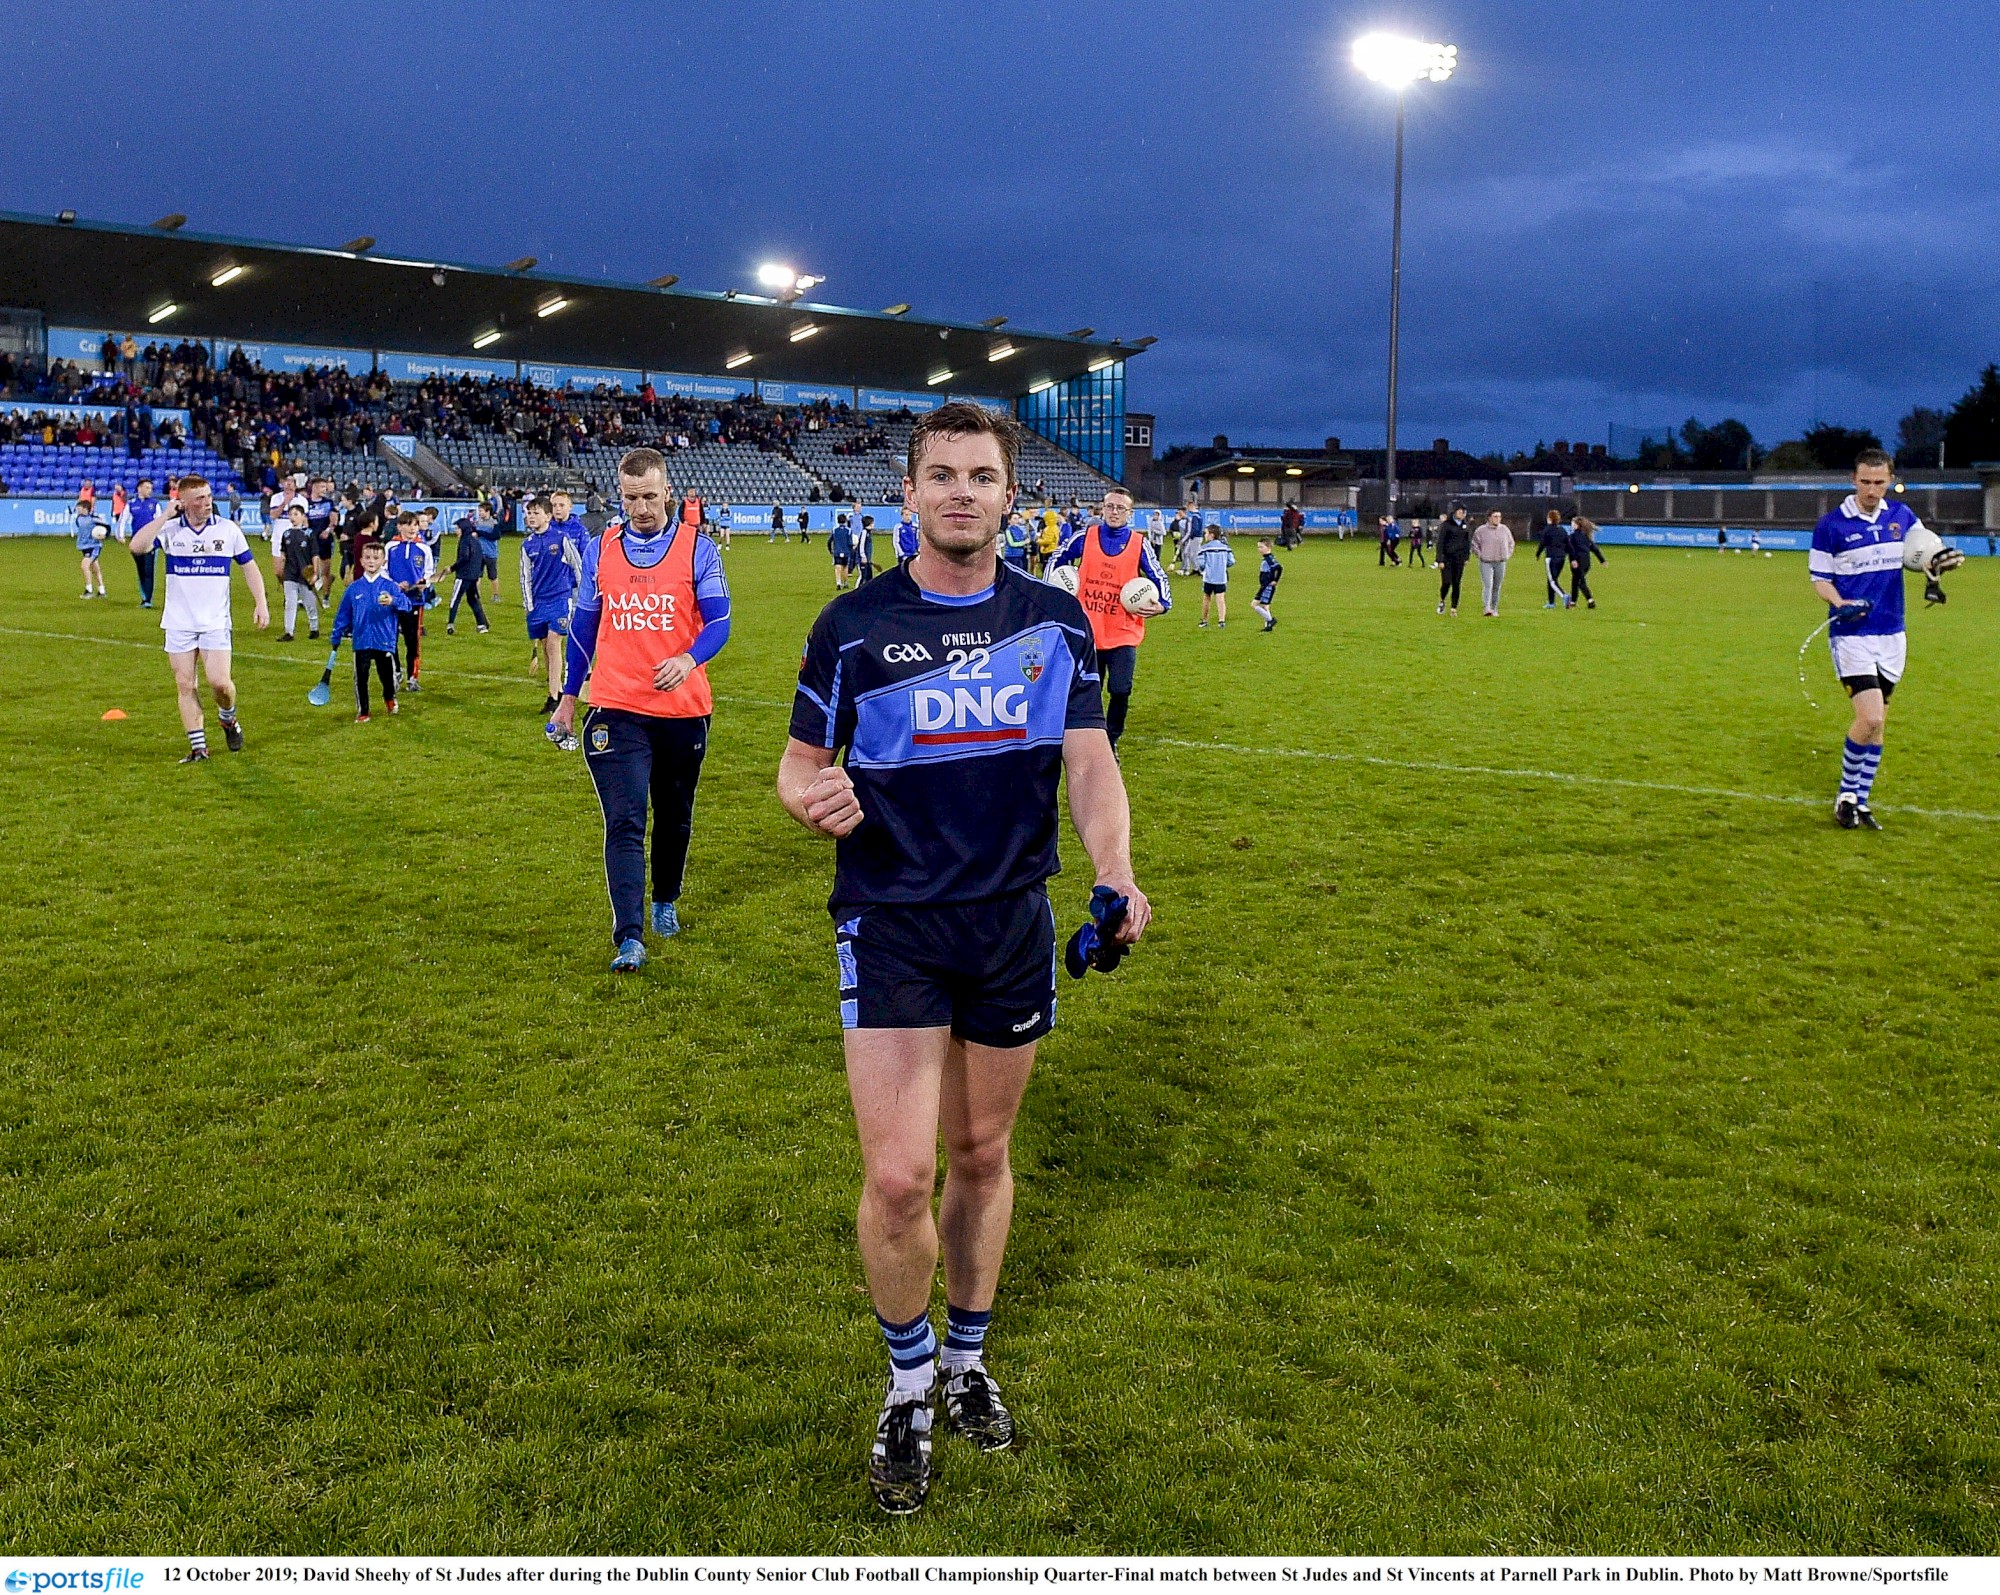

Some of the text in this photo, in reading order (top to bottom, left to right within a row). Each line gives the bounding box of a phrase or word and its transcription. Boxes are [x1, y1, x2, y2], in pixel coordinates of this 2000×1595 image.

[407, 362, 439, 375] Home
[531, 370, 551, 383] AIG
[666, 381, 736, 395] Travel Insurance
[766, 388, 782, 399] AIG
[734, 512, 762, 524] Home
[192, 544, 205, 553] 24
[174, 565, 225, 574] Bank of Ireland
[607, 592, 676, 612] MAOR
[1084, 588, 1120, 604] MAOR
[611, 612, 675, 631] UISCE
[942, 631, 992, 647] O'NEILLS
[946, 648, 993, 681] 22
[914, 684, 1028, 731] DNG
